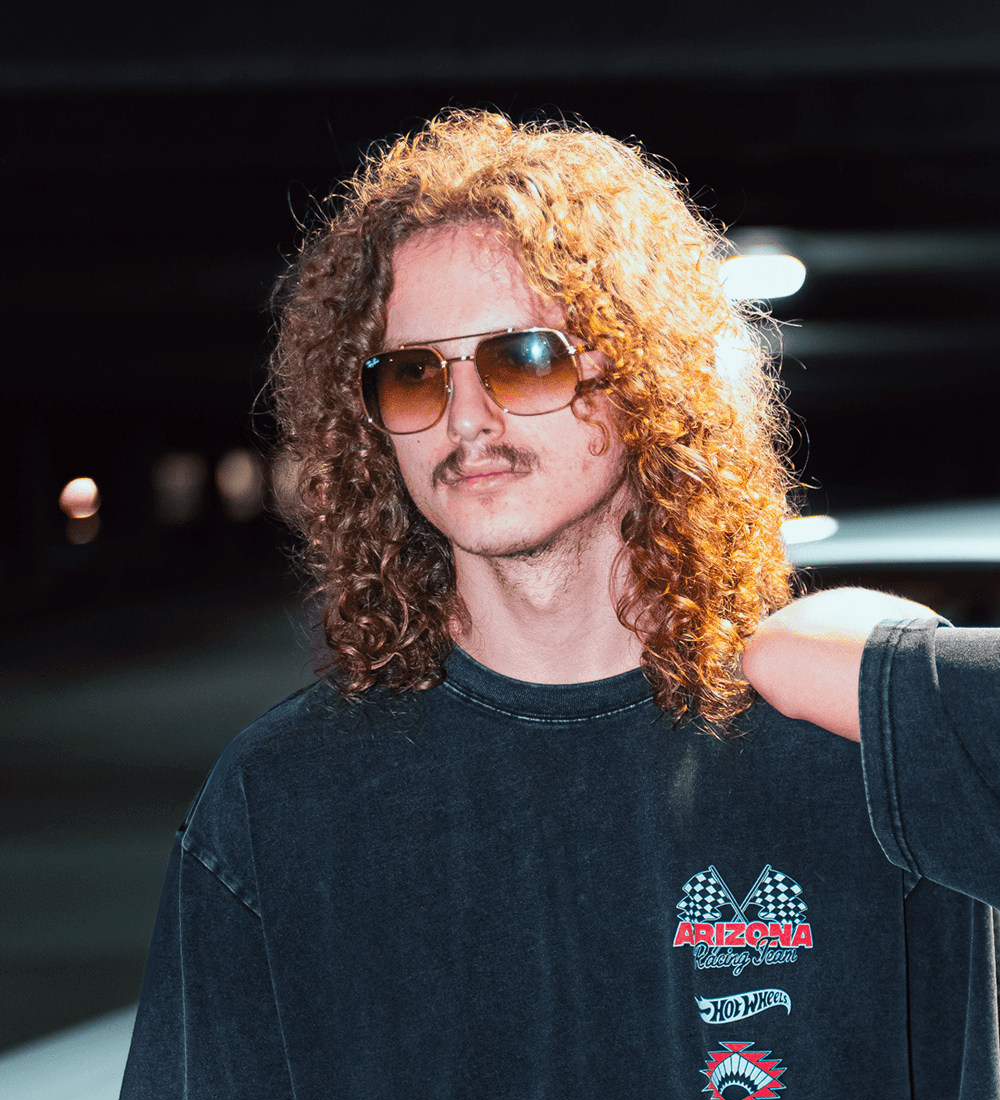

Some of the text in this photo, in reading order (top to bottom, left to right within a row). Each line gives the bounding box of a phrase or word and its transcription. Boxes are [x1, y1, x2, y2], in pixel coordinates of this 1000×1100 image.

[673, 921, 814, 949] ARIZONA
[694, 936, 798, 977] Racing Team
[710, 1001, 741, 1022] HOT
